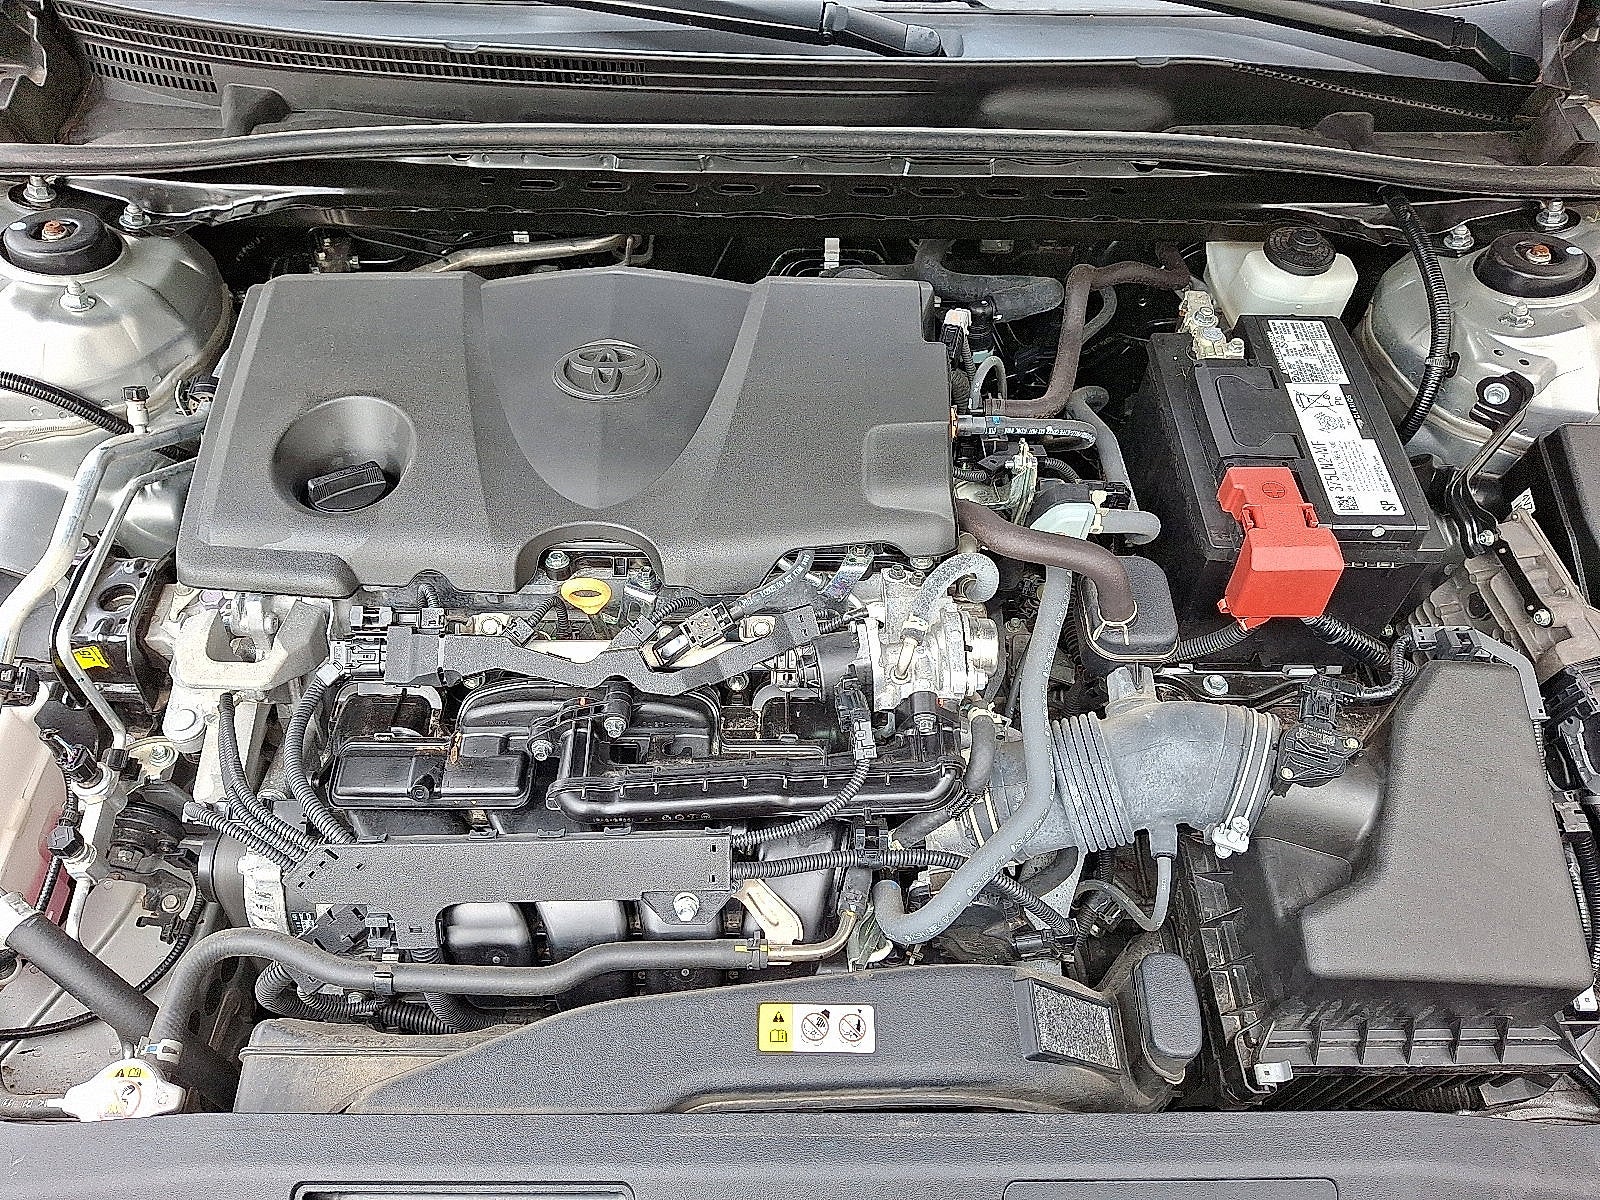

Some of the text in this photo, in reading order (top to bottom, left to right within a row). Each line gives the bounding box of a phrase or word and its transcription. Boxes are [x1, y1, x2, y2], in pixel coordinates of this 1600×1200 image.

[1346, 394, 1361, 419] CLARIOS
[1311, 441, 1344, 492] 375LN2-MF
[1380, 501, 1398, 512] SP
